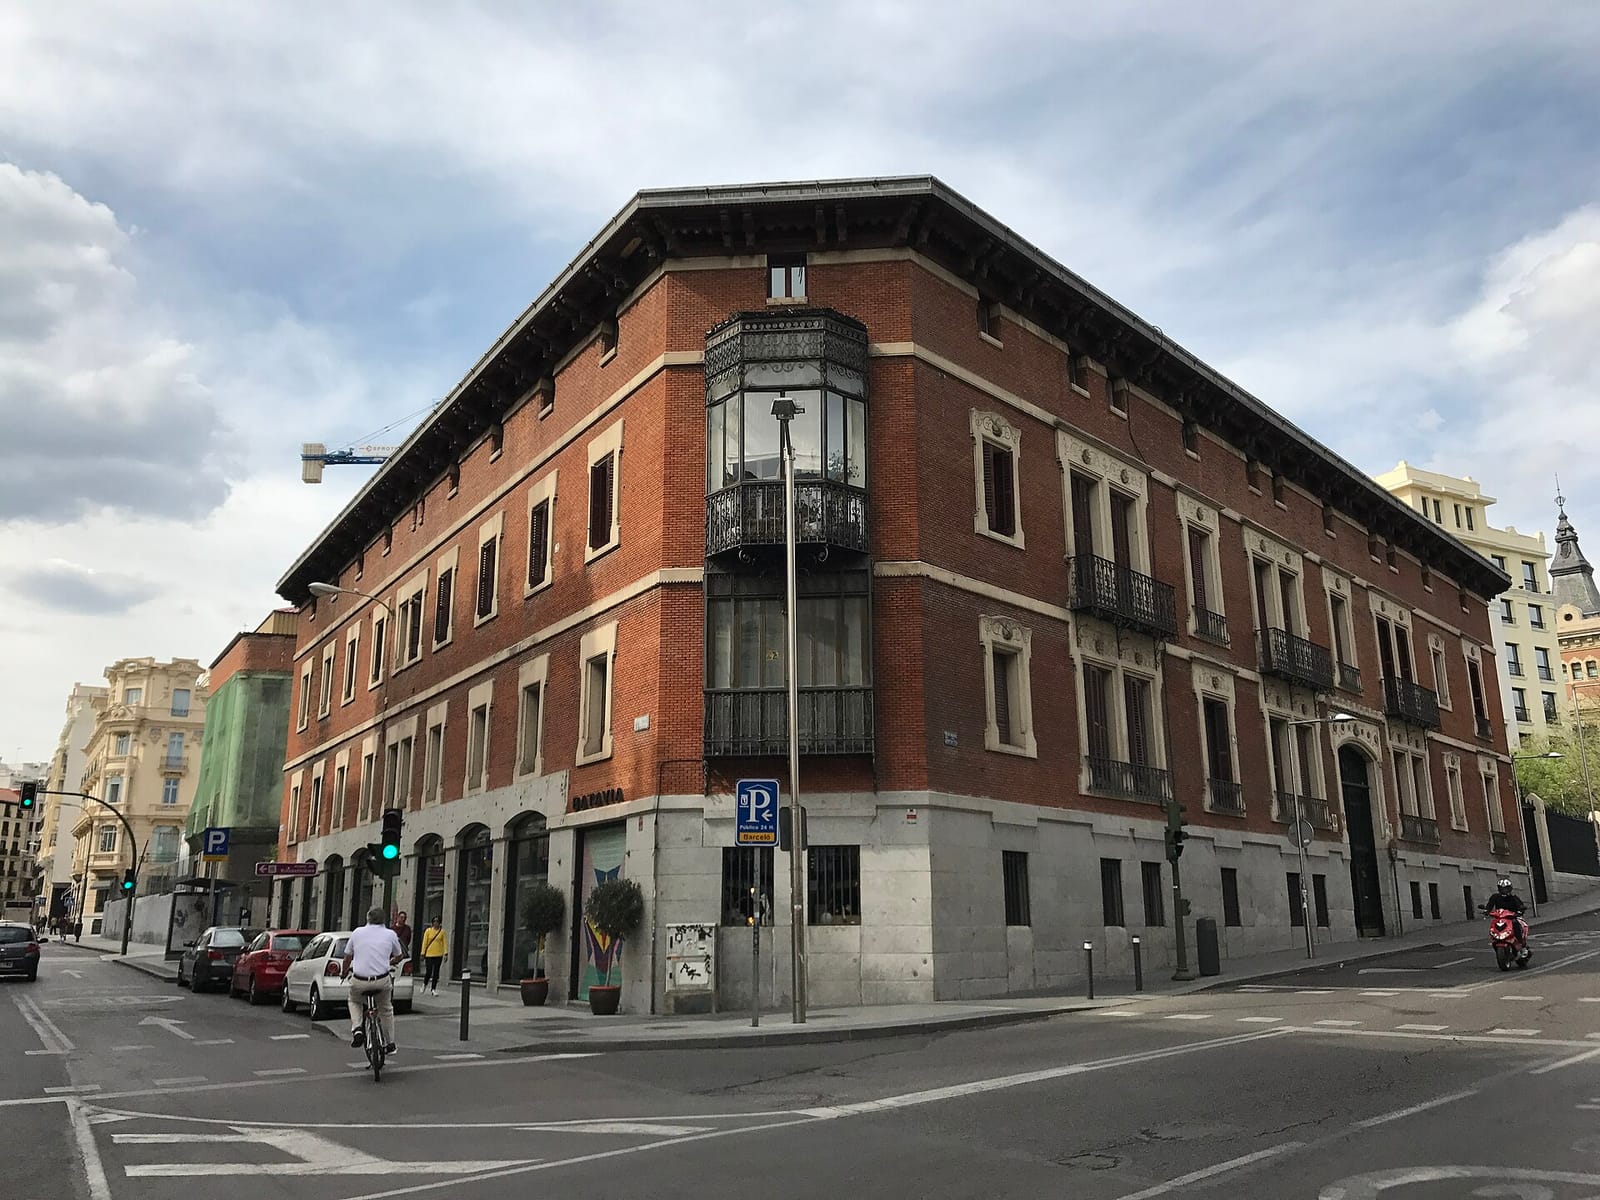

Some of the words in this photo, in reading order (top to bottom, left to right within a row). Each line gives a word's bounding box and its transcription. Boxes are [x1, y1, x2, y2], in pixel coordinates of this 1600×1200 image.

[573, 787, 625, 811] BATAVIA
[746, 789, 771, 823] P
[207, 830, 227, 853] P
